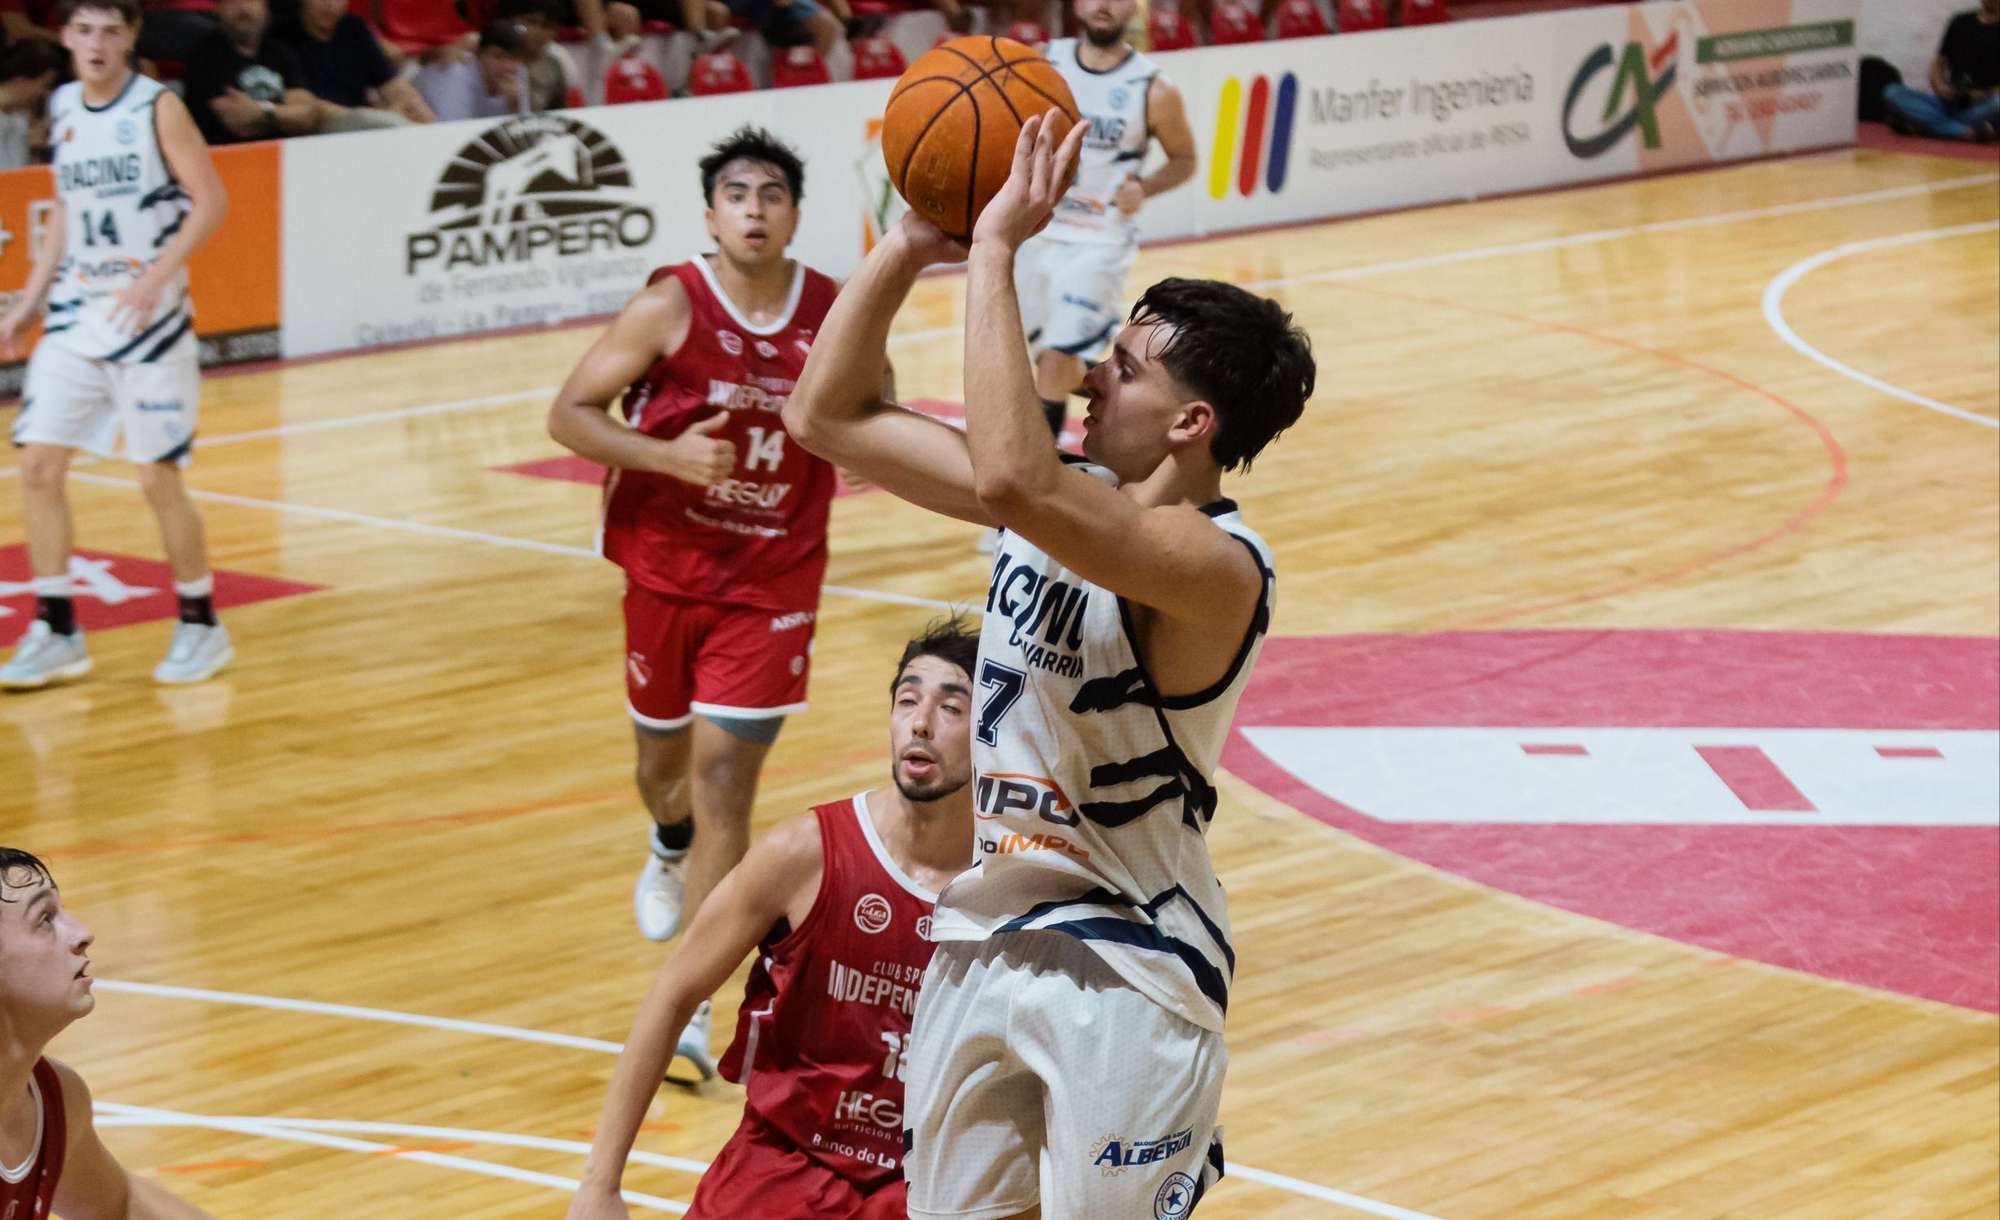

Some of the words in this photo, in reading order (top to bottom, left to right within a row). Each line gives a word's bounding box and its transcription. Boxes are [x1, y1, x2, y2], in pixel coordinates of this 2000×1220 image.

[1311, 79, 1405, 124] Manfer
[61, 153, 141, 191] RACING
[81, 210, 120, 247] 14
[405, 206, 655, 274] PAMPERO
[744, 426, 785, 472] 14
[975, 657, 1027, 747] 7
[873, 960, 901, 980] CLUB
[812, 1132, 855, 1157] Banco
[857, 1147, 876, 1164] de
[877, 1151, 897, 1170] La
